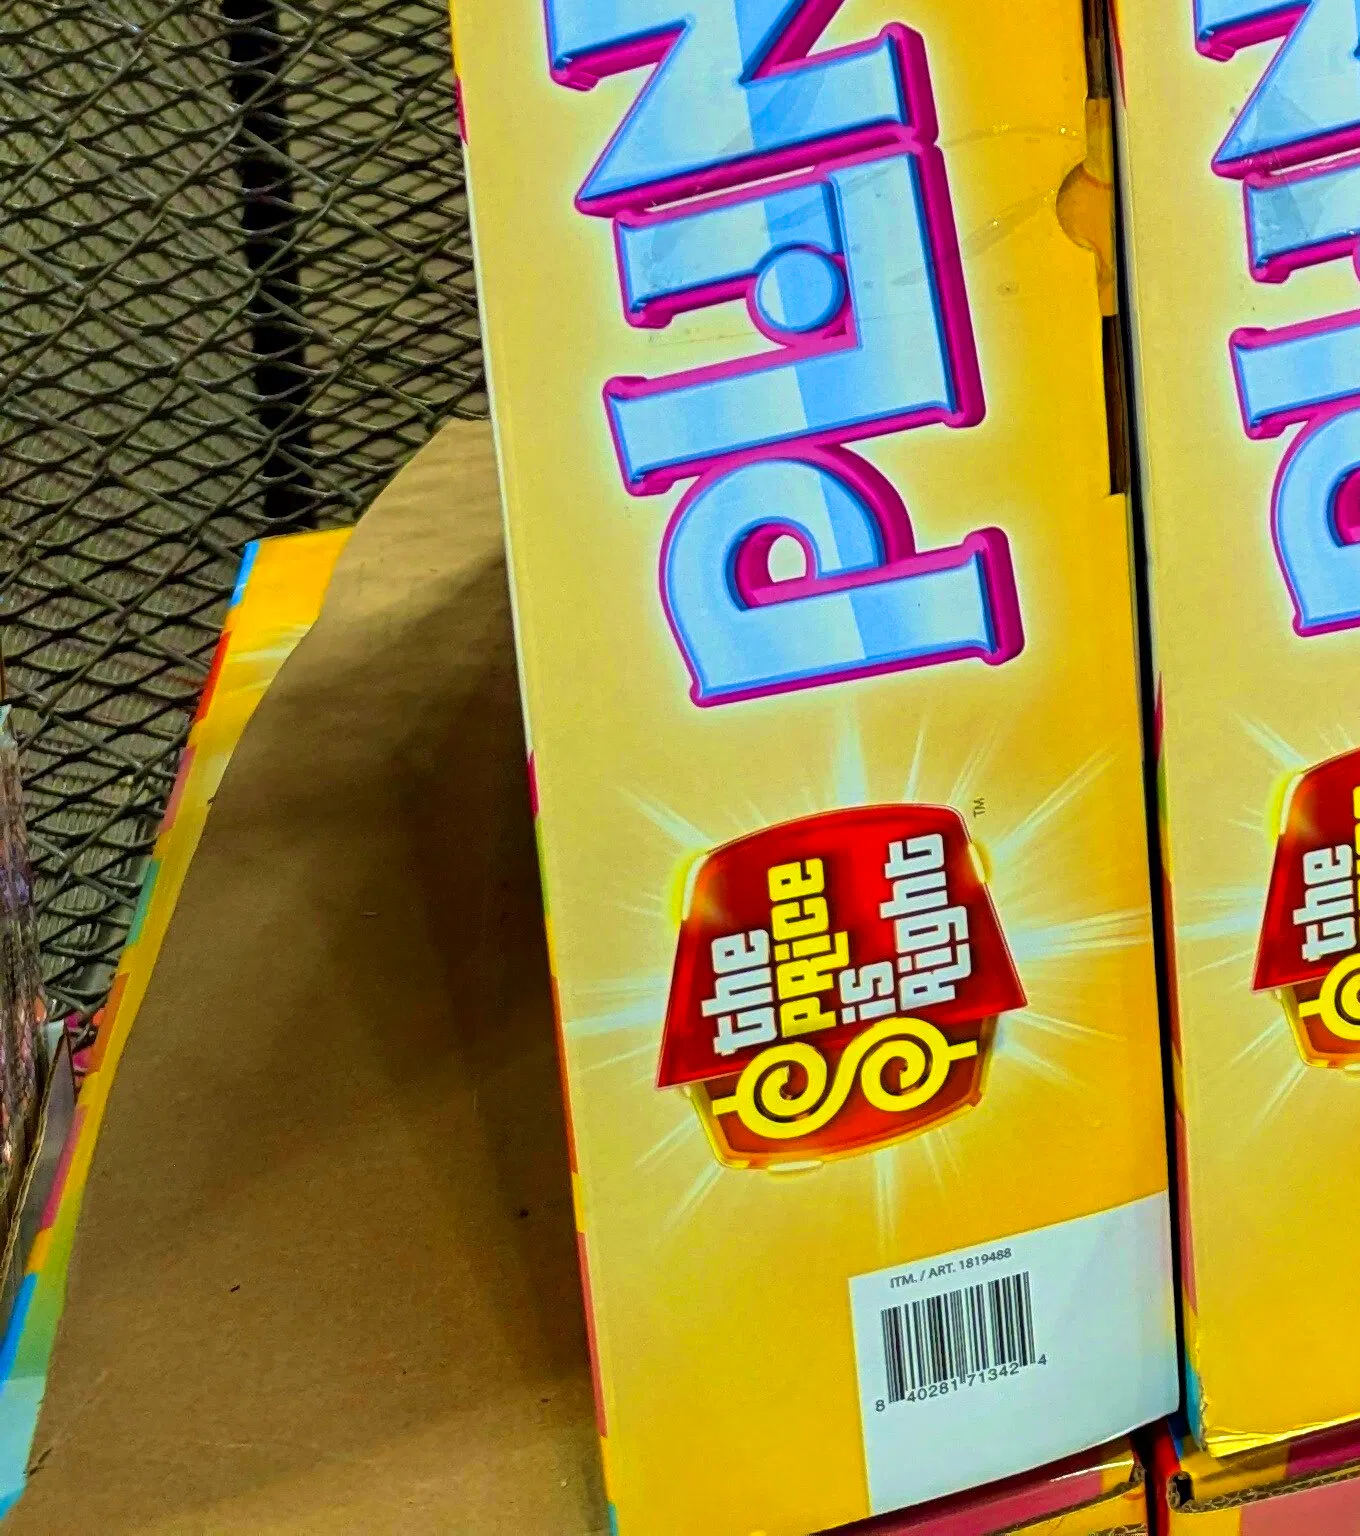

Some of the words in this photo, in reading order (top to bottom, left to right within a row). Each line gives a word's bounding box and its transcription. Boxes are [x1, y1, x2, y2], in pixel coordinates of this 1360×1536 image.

[879, 833, 972, 1010] Right
[1293, 842, 1356, 964] the
[701, 929, 777, 1055] the
[840, 961, 896, 1025] is
[889, 1275, 917, 1289] ITM.
[928, 1262, 956, 1279] ART.
[959, 1247, 1012, 1270] 1819488
[875, 1399, 885, 1412] 8
[907, 1379, 958, 1403] 40281
[968, 1362, 1019, 1387] 71342
[1038, 1353, 1047, 1365] 4
